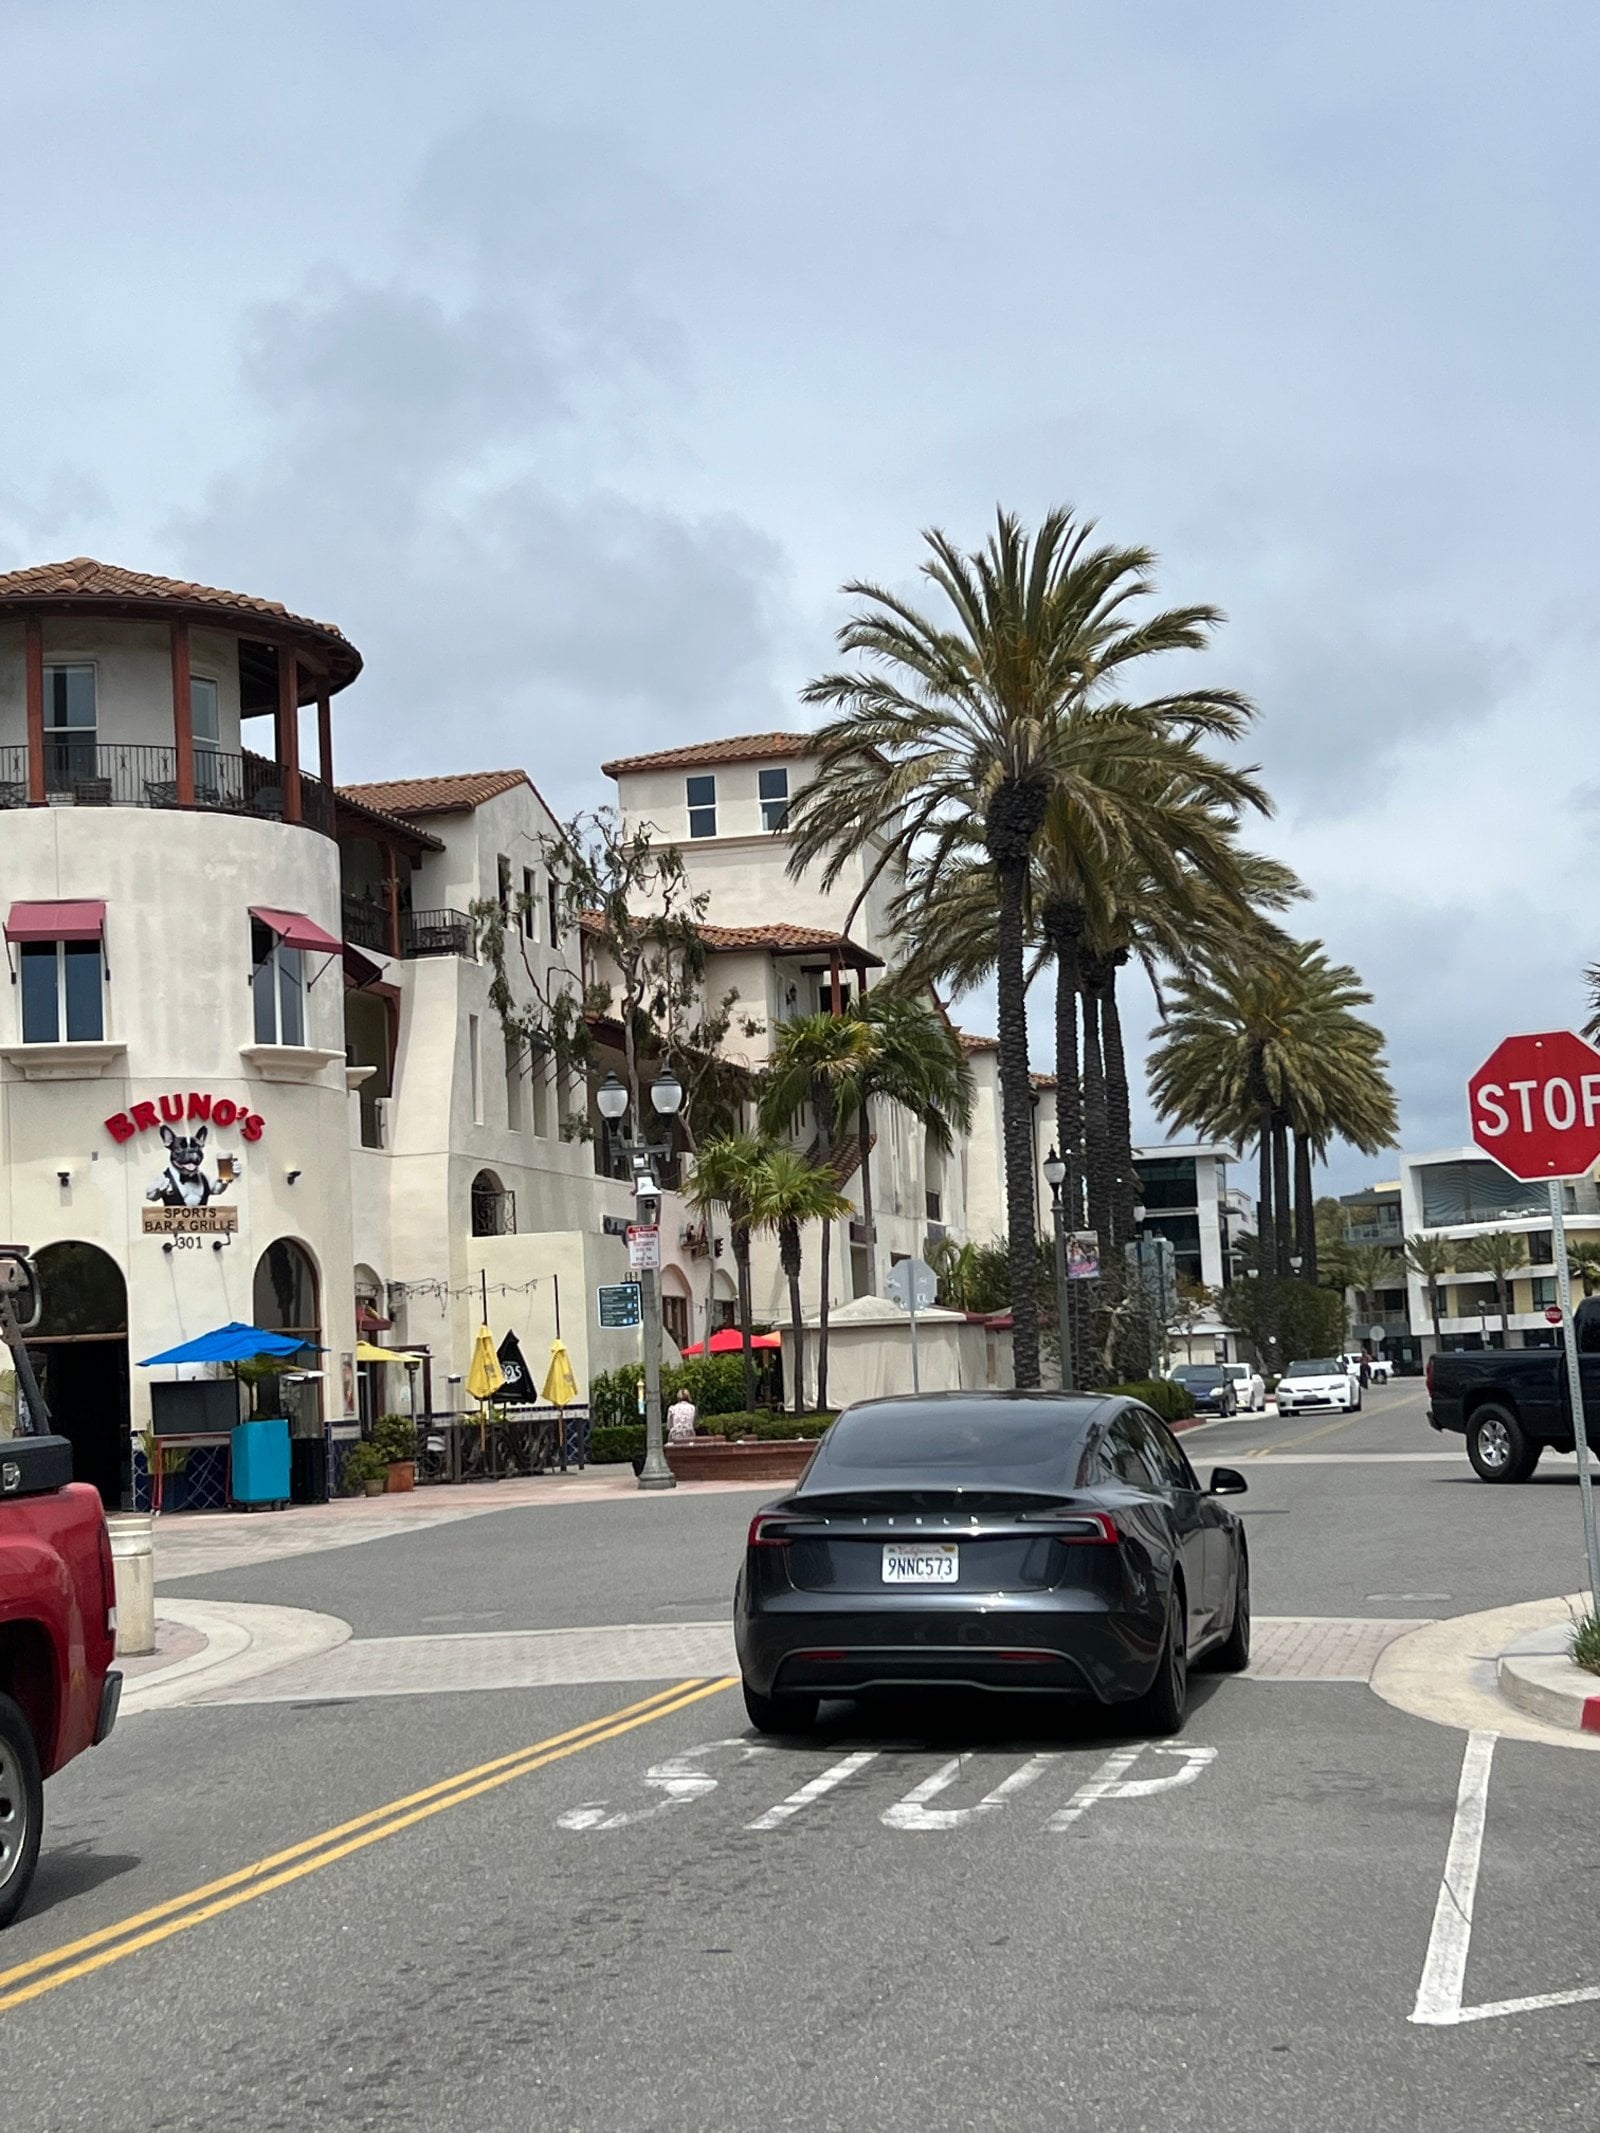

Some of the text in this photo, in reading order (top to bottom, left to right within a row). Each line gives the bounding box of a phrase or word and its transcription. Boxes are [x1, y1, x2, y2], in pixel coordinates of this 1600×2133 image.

[1477, 1074, 1600, 1136] STOP
[104, 1092, 266, 1145] BRUNO'S
[163, 1207, 217, 1219] SPORTS
[144, 1220, 236, 1232] BAR & GRILLE
[177, 1236, 203, 1250] 301
[888, 1557, 953, 1576] 9NNC573
